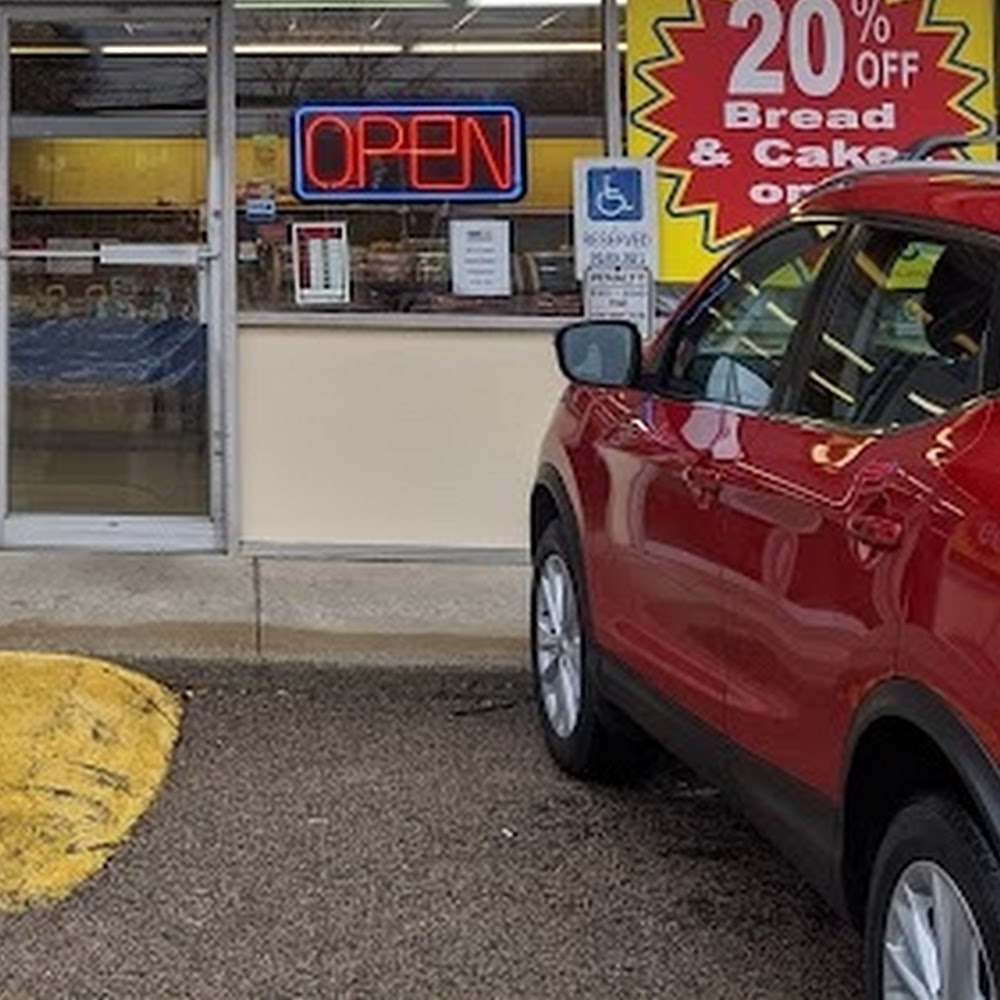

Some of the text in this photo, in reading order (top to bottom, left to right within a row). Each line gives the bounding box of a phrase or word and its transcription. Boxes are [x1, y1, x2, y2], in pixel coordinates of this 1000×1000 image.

[856, 51, 919, 89] OFF
[723, 102, 896, 130] Bread
[304, 113, 511, 190] OPEN
[689, 138, 899, 168] & Cake
